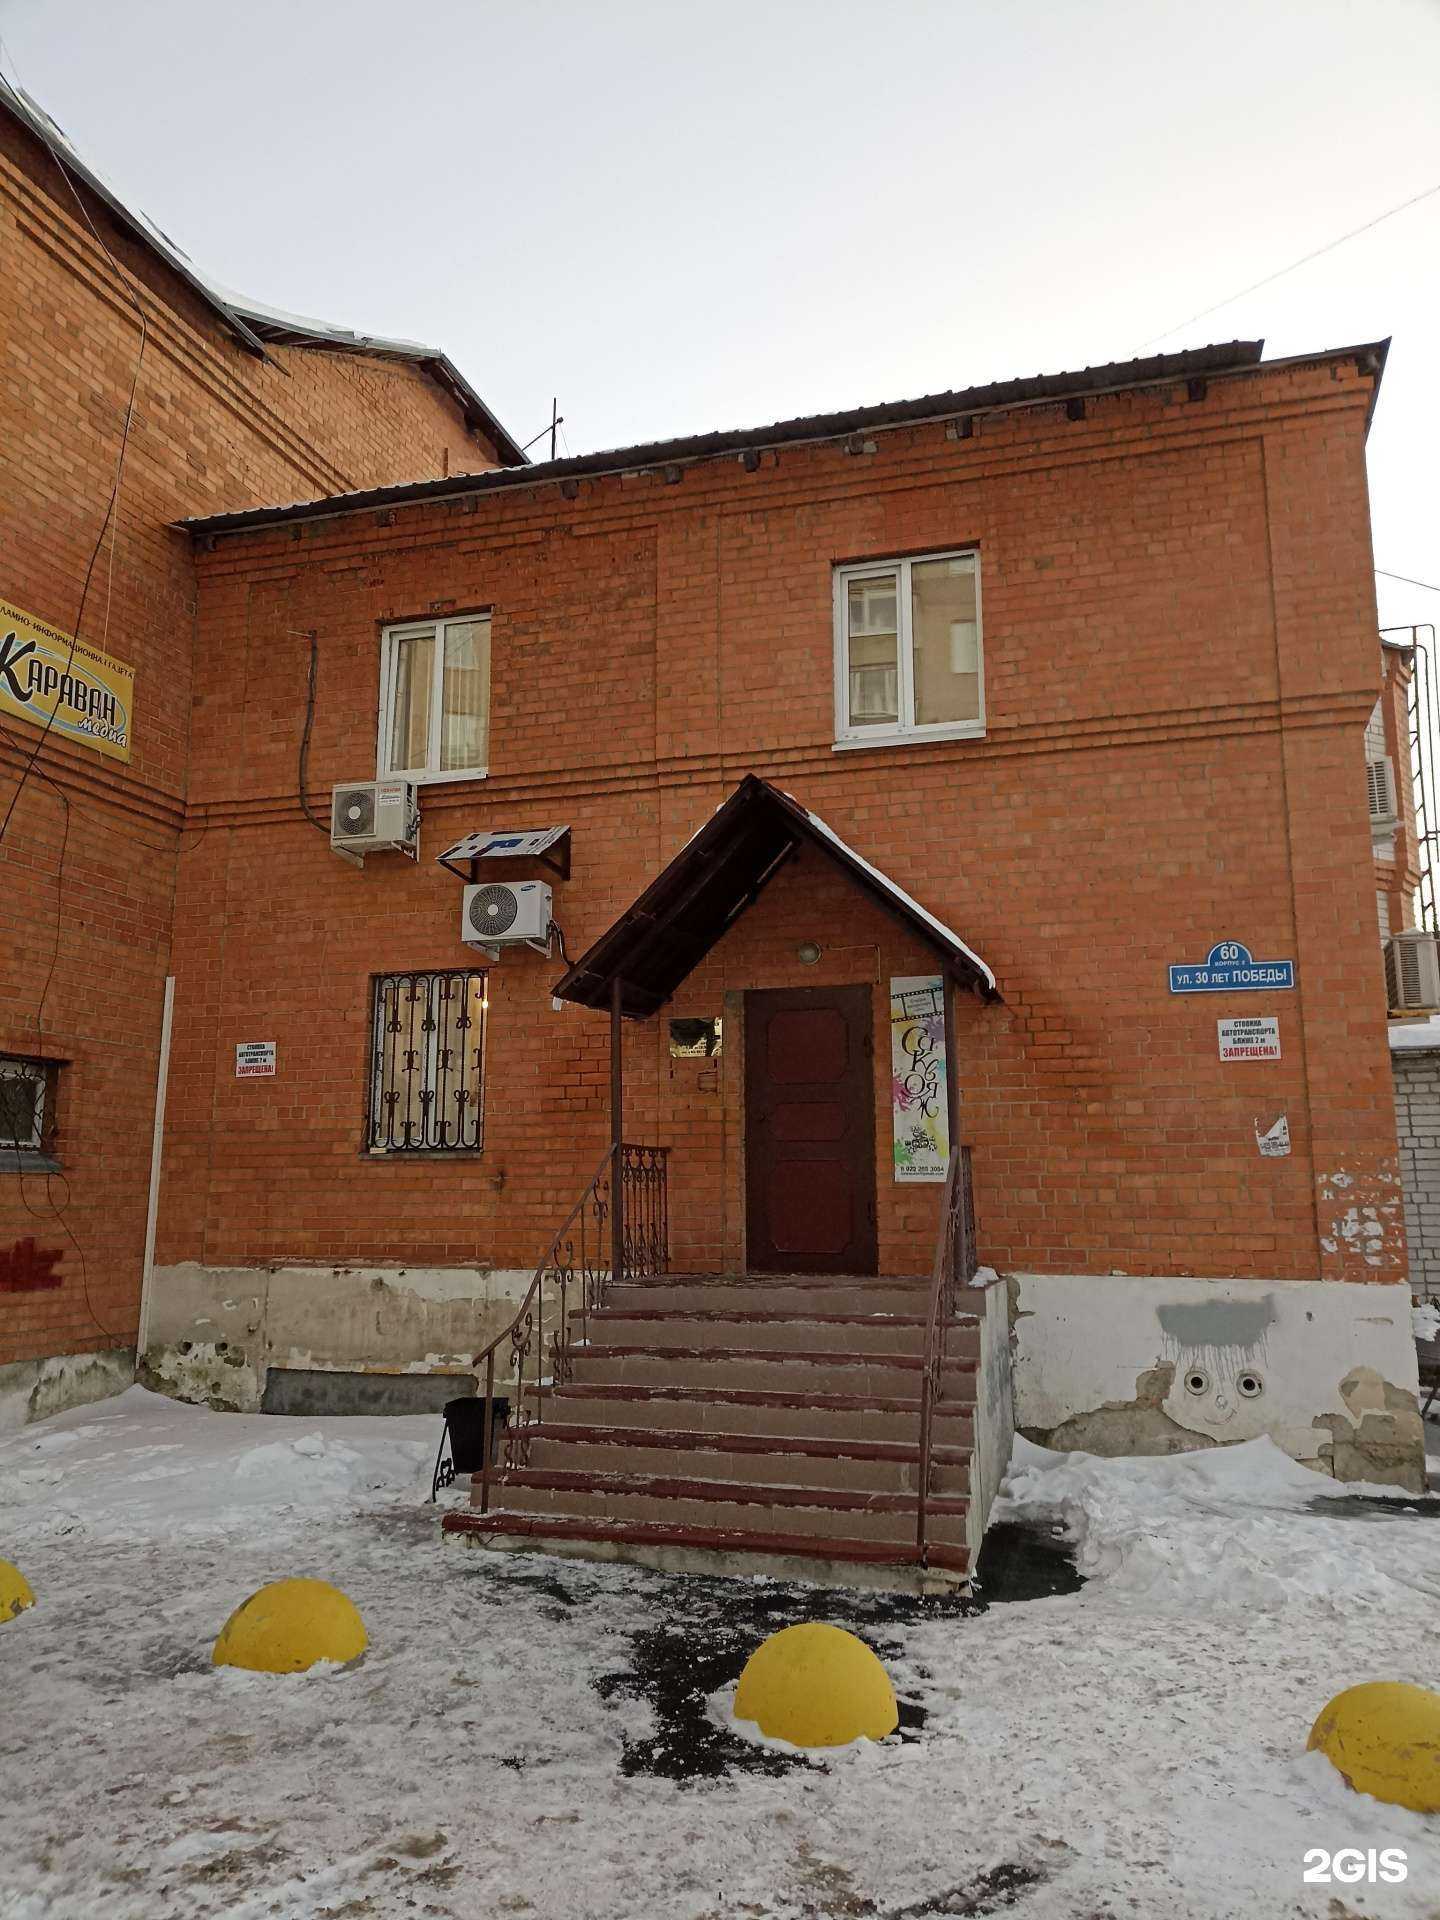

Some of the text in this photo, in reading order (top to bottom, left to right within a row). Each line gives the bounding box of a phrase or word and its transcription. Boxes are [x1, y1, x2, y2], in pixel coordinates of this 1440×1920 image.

[1220, 945, 1239, 960] 60
[1195, 972, 1209, 984] 30
[1232, 968, 1287, 983] ПОБЕДЫ
[1233, 1020, 1262, 1028] СТОЯНКА
[1221, 1028, 1276, 1036] АВТОТРАНСПОРТА
[1232, 1037, 1254, 1045] БЛИЖЕ
[1222, 1046, 1278, 1058] ЗАПРЕЩЕНА!
